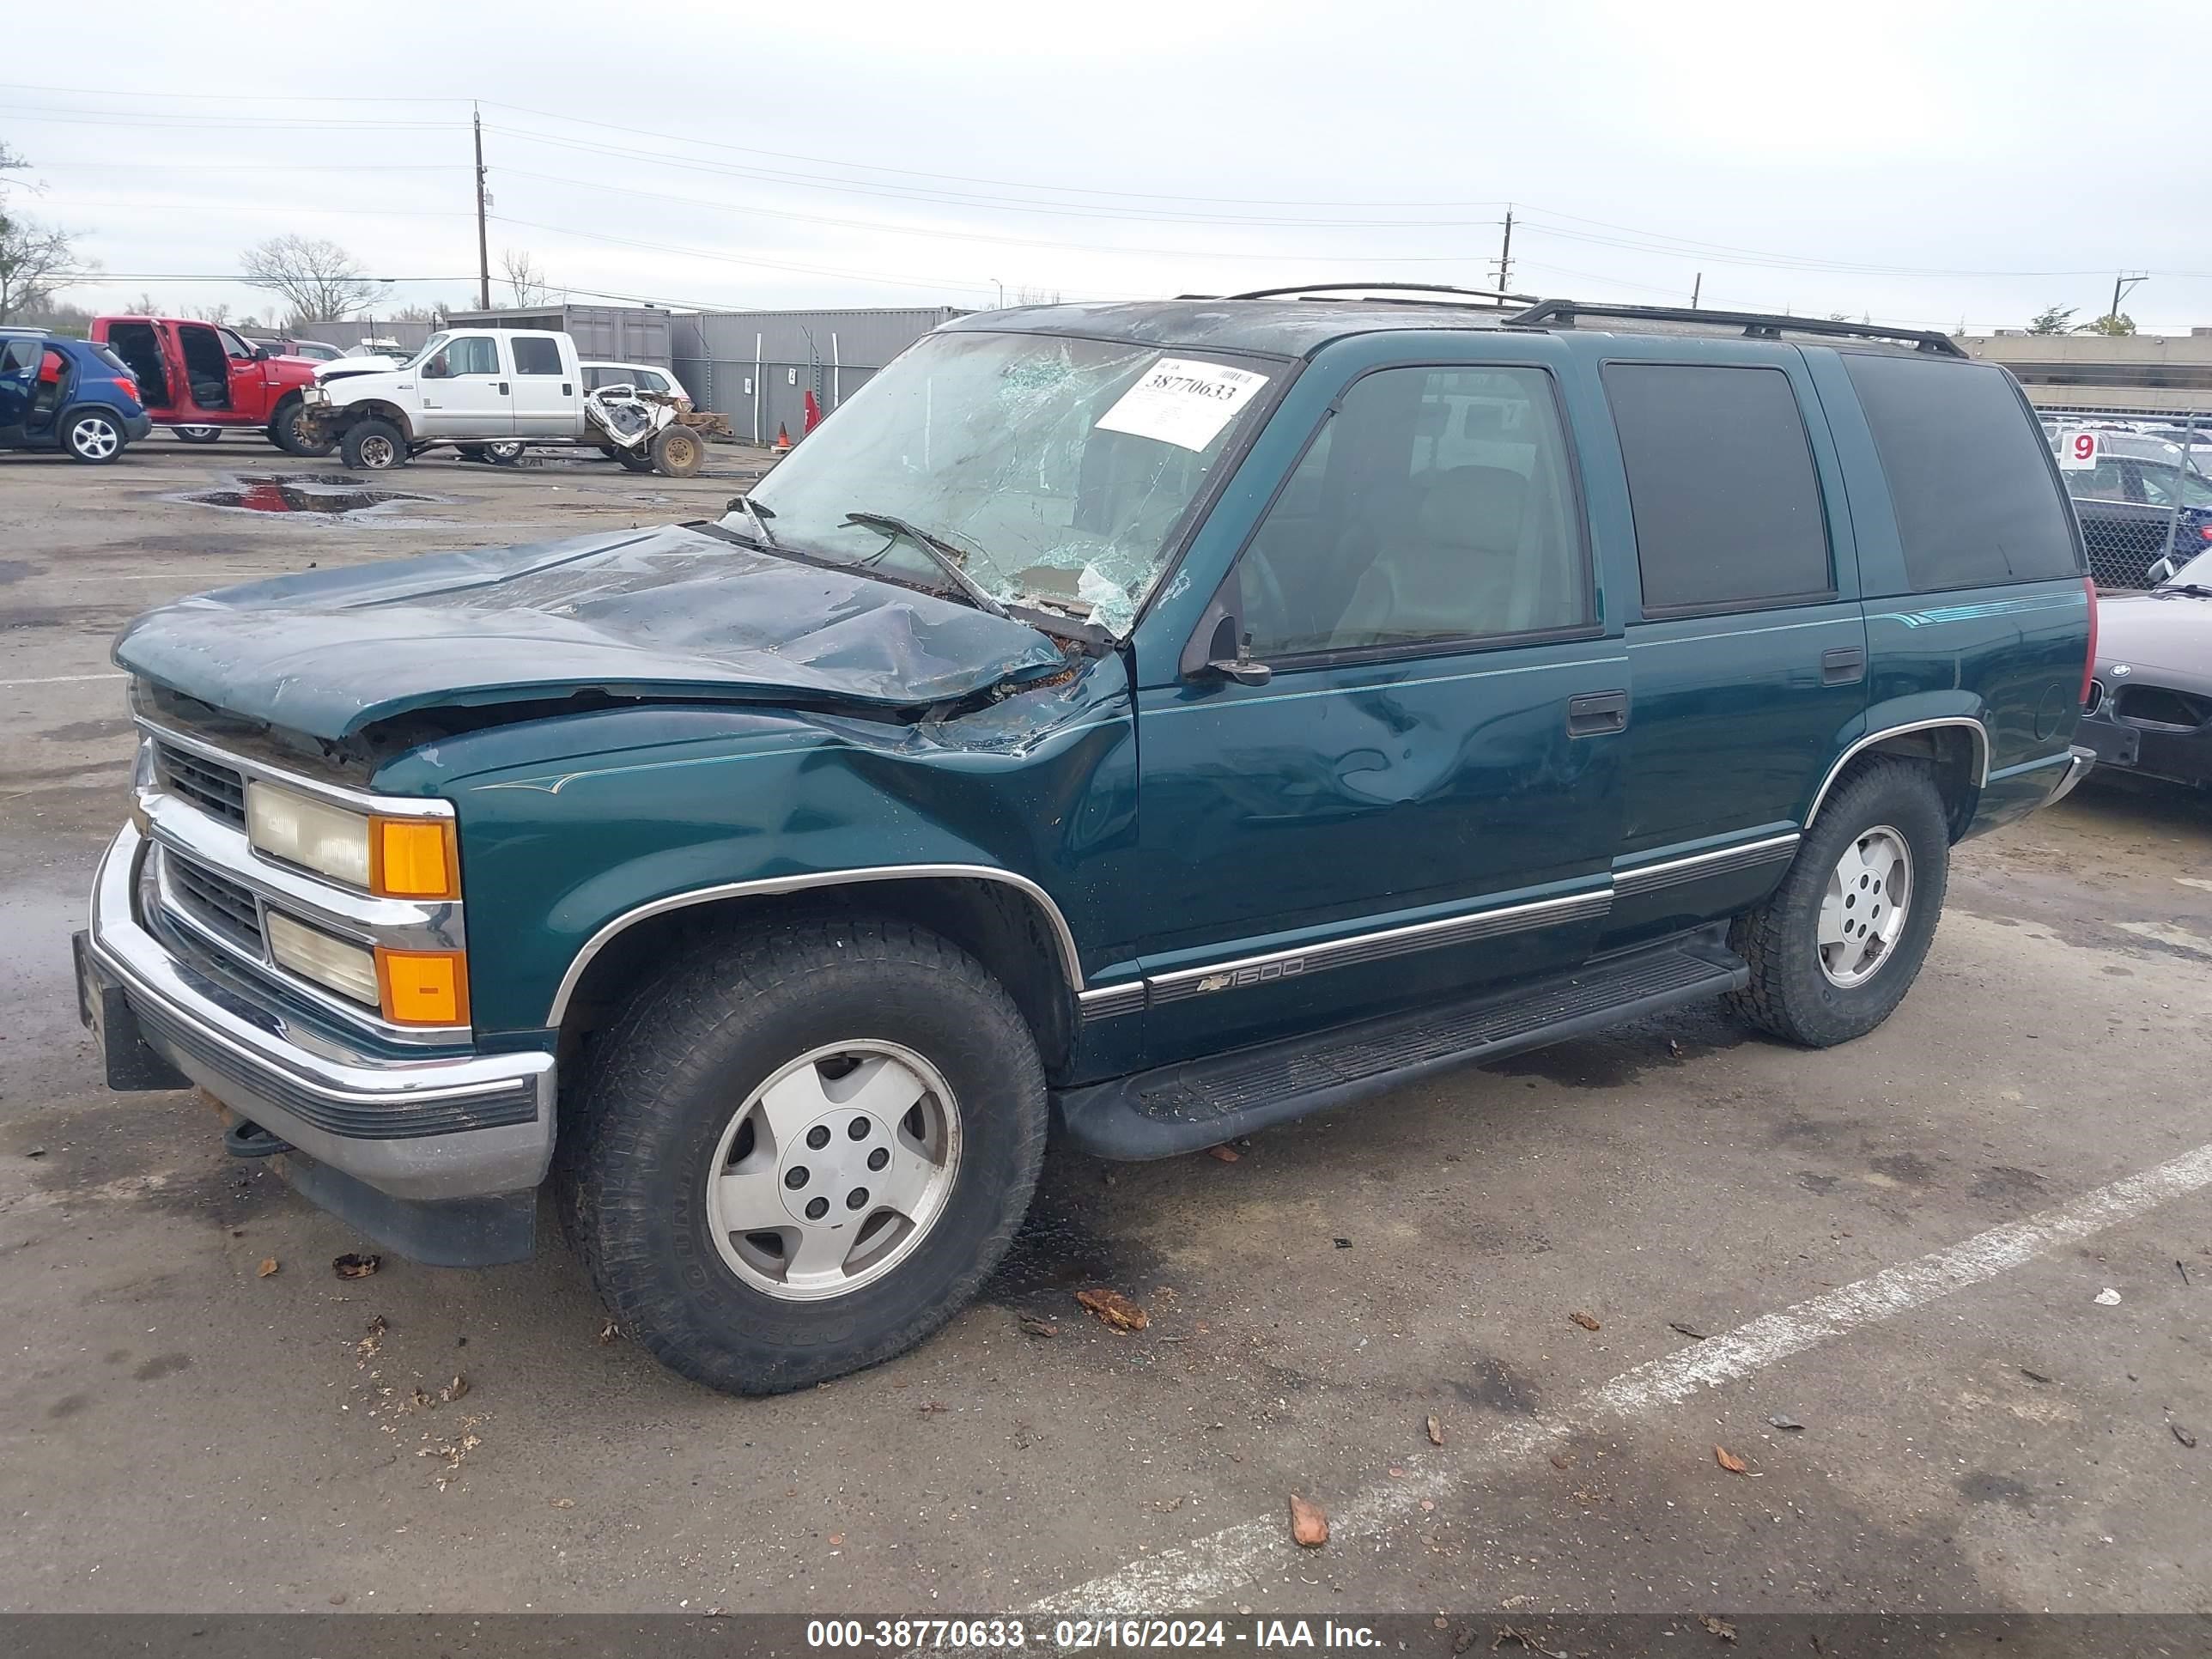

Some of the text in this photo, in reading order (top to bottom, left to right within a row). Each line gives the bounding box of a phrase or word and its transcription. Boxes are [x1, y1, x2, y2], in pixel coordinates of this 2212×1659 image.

[789, 370, 795, 380] 2
[1145, 374, 1237, 401] 38770633
[2074, 434, 2094, 460] 9
[1230, 959, 1304, 987] 1500
